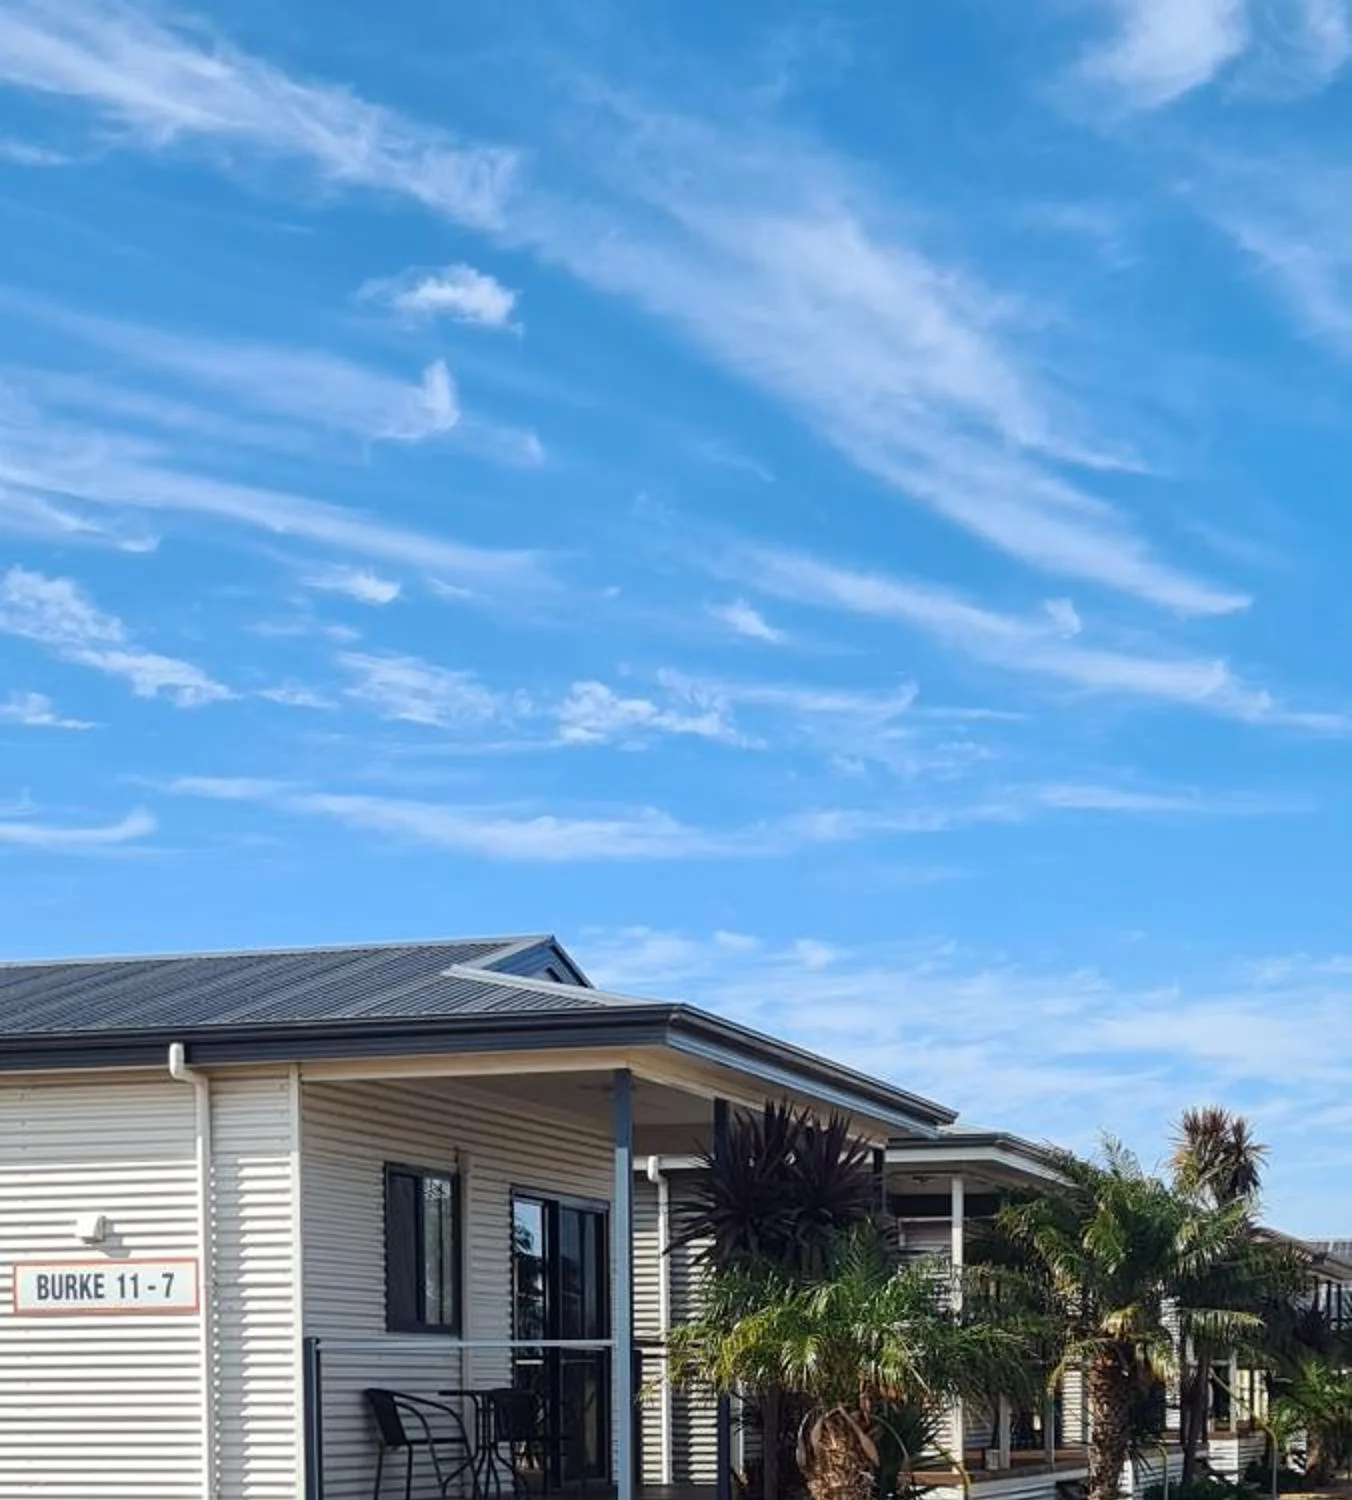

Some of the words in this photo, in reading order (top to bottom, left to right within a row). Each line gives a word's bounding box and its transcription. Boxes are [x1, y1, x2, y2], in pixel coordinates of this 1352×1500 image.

[36, 1273, 105, 1301] BURKE
[117, 1273, 139, 1299] 11
[161, 1272, 175, 1298] 7
